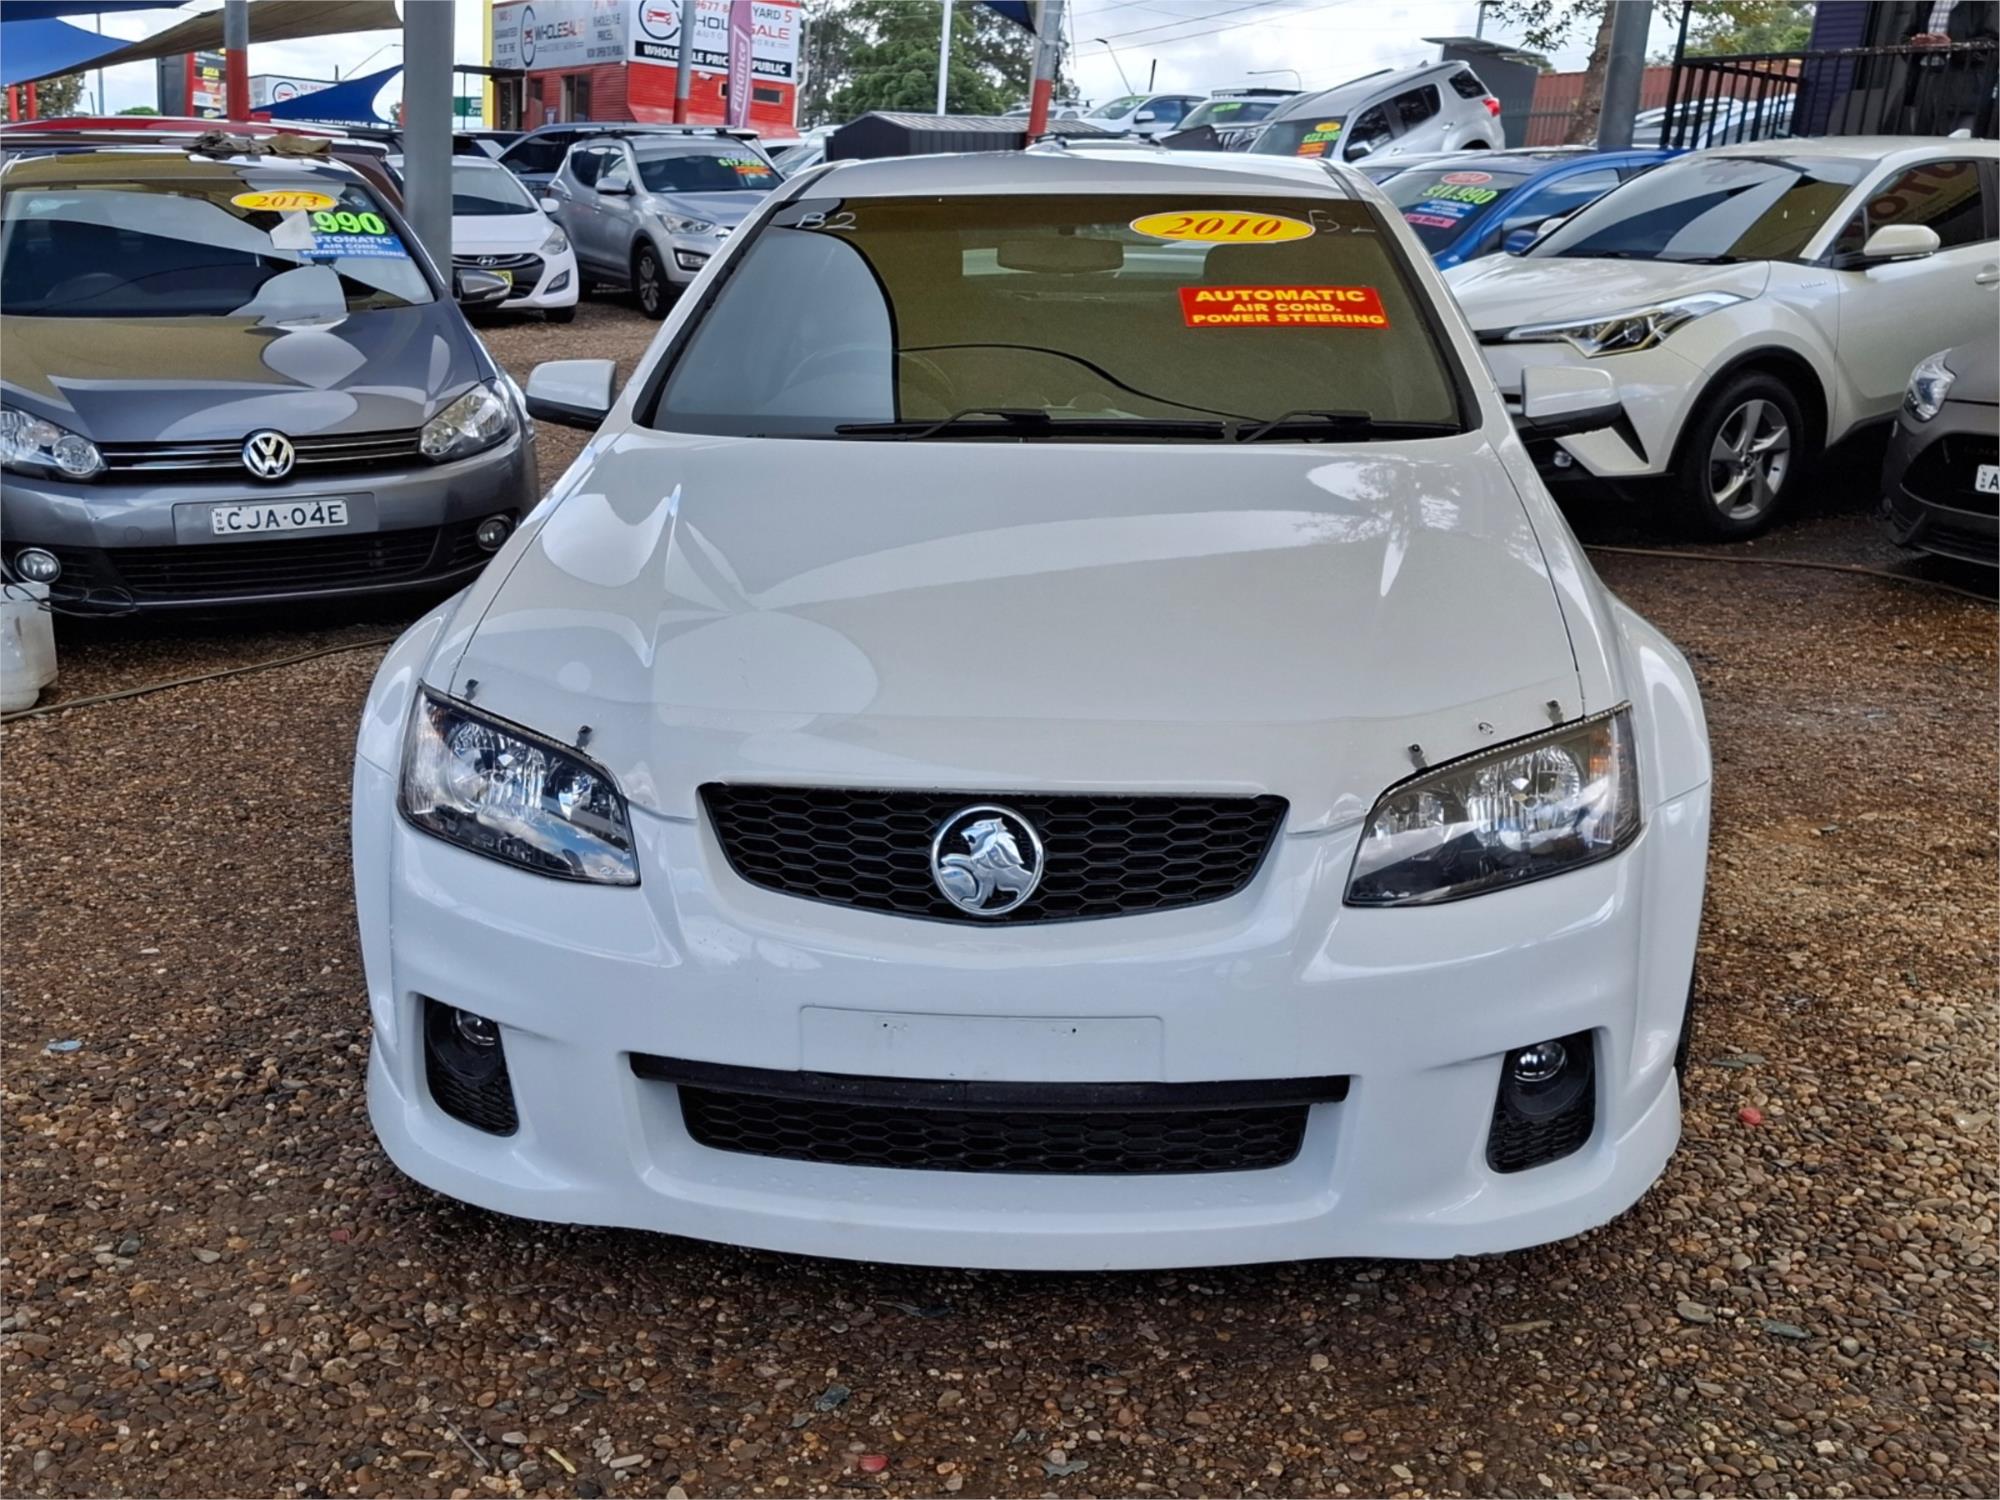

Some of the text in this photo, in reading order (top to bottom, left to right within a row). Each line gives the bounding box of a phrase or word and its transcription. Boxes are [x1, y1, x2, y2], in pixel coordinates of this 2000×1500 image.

[752, 6, 793, 24] YARD 5
[751, 60, 787, 75] PUBLIC
[253, 195, 319, 207] 2013
[795, 211, 857, 230] B2
[1163, 216, 1283, 237] 2010
[313, 235, 393, 246] UTOMATIC
[355, 250, 407, 258] STEERING
[1195, 289, 1366, 303] AUTOMATIC
[1232, 303, 1342, 313] AIR COND.
[1191, 313, 1386, 325] POWER STEERING
